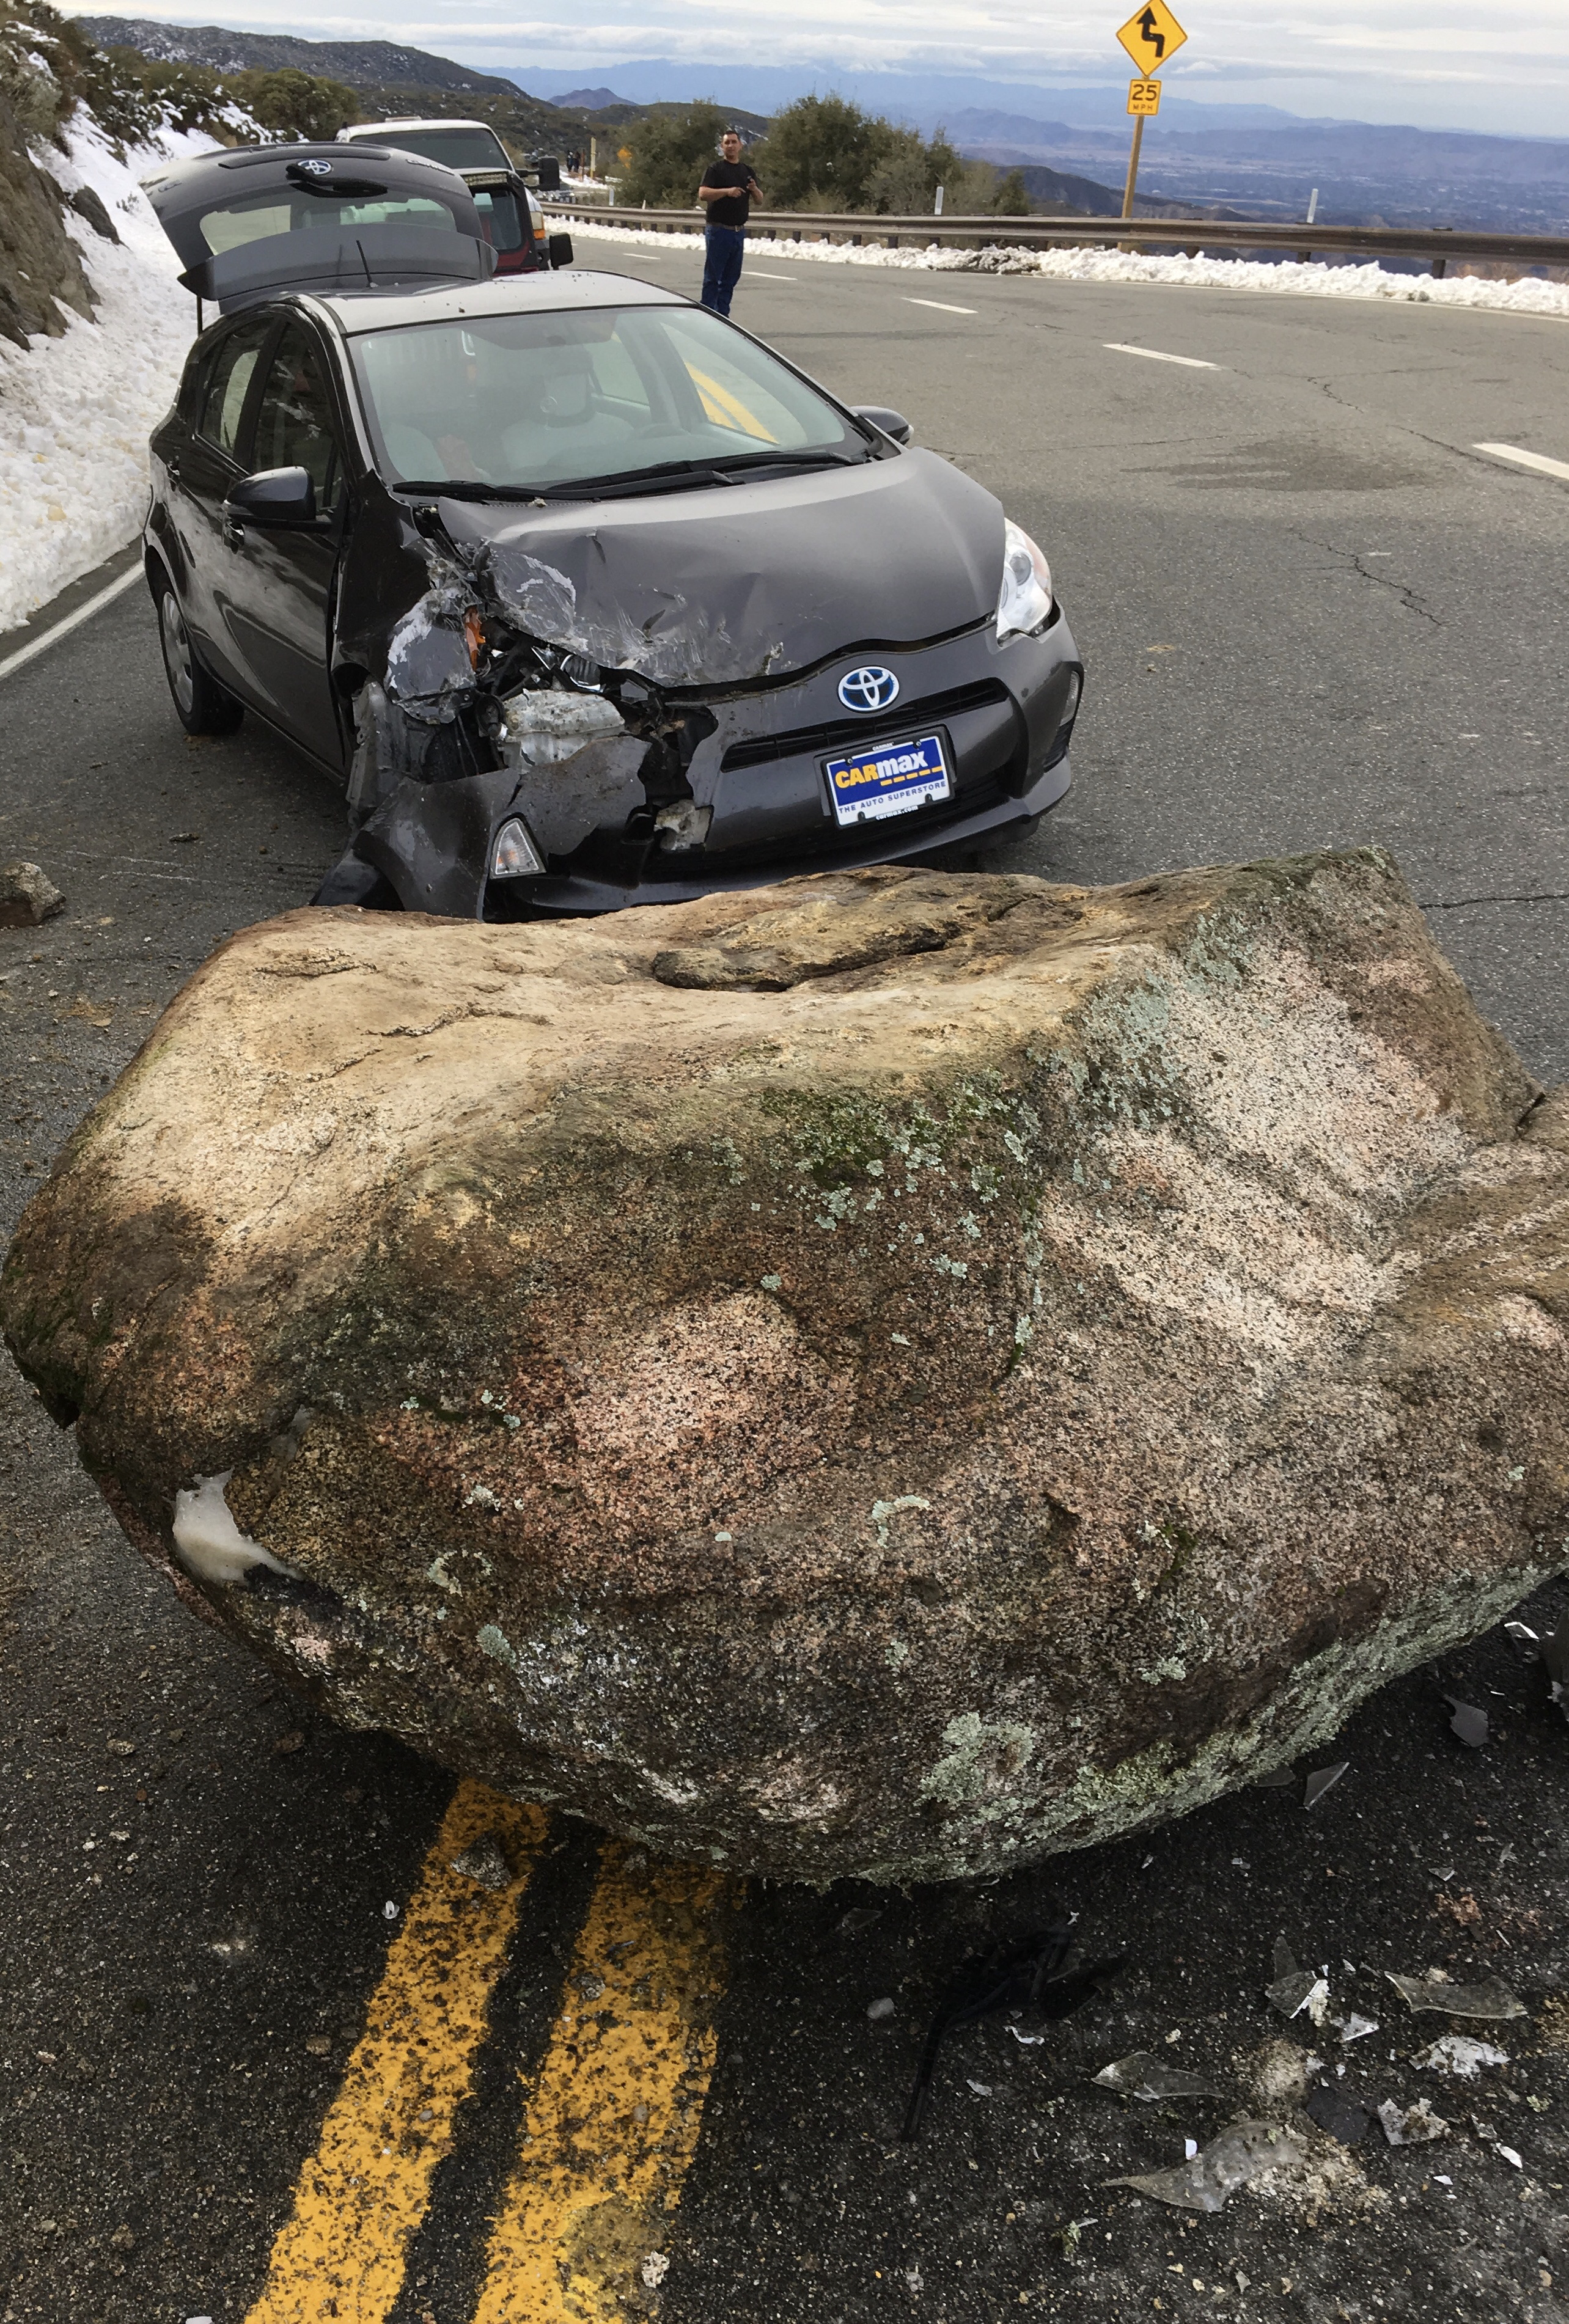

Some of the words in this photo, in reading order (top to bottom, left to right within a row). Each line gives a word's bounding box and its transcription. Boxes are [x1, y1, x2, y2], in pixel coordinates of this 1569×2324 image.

[1131, 84, 1157, 101] 25
[839, 802, 856, 814] THE
[861, 797, 884, 808] AUTO
[887, 781, 946, 801] SUPERSTORE
